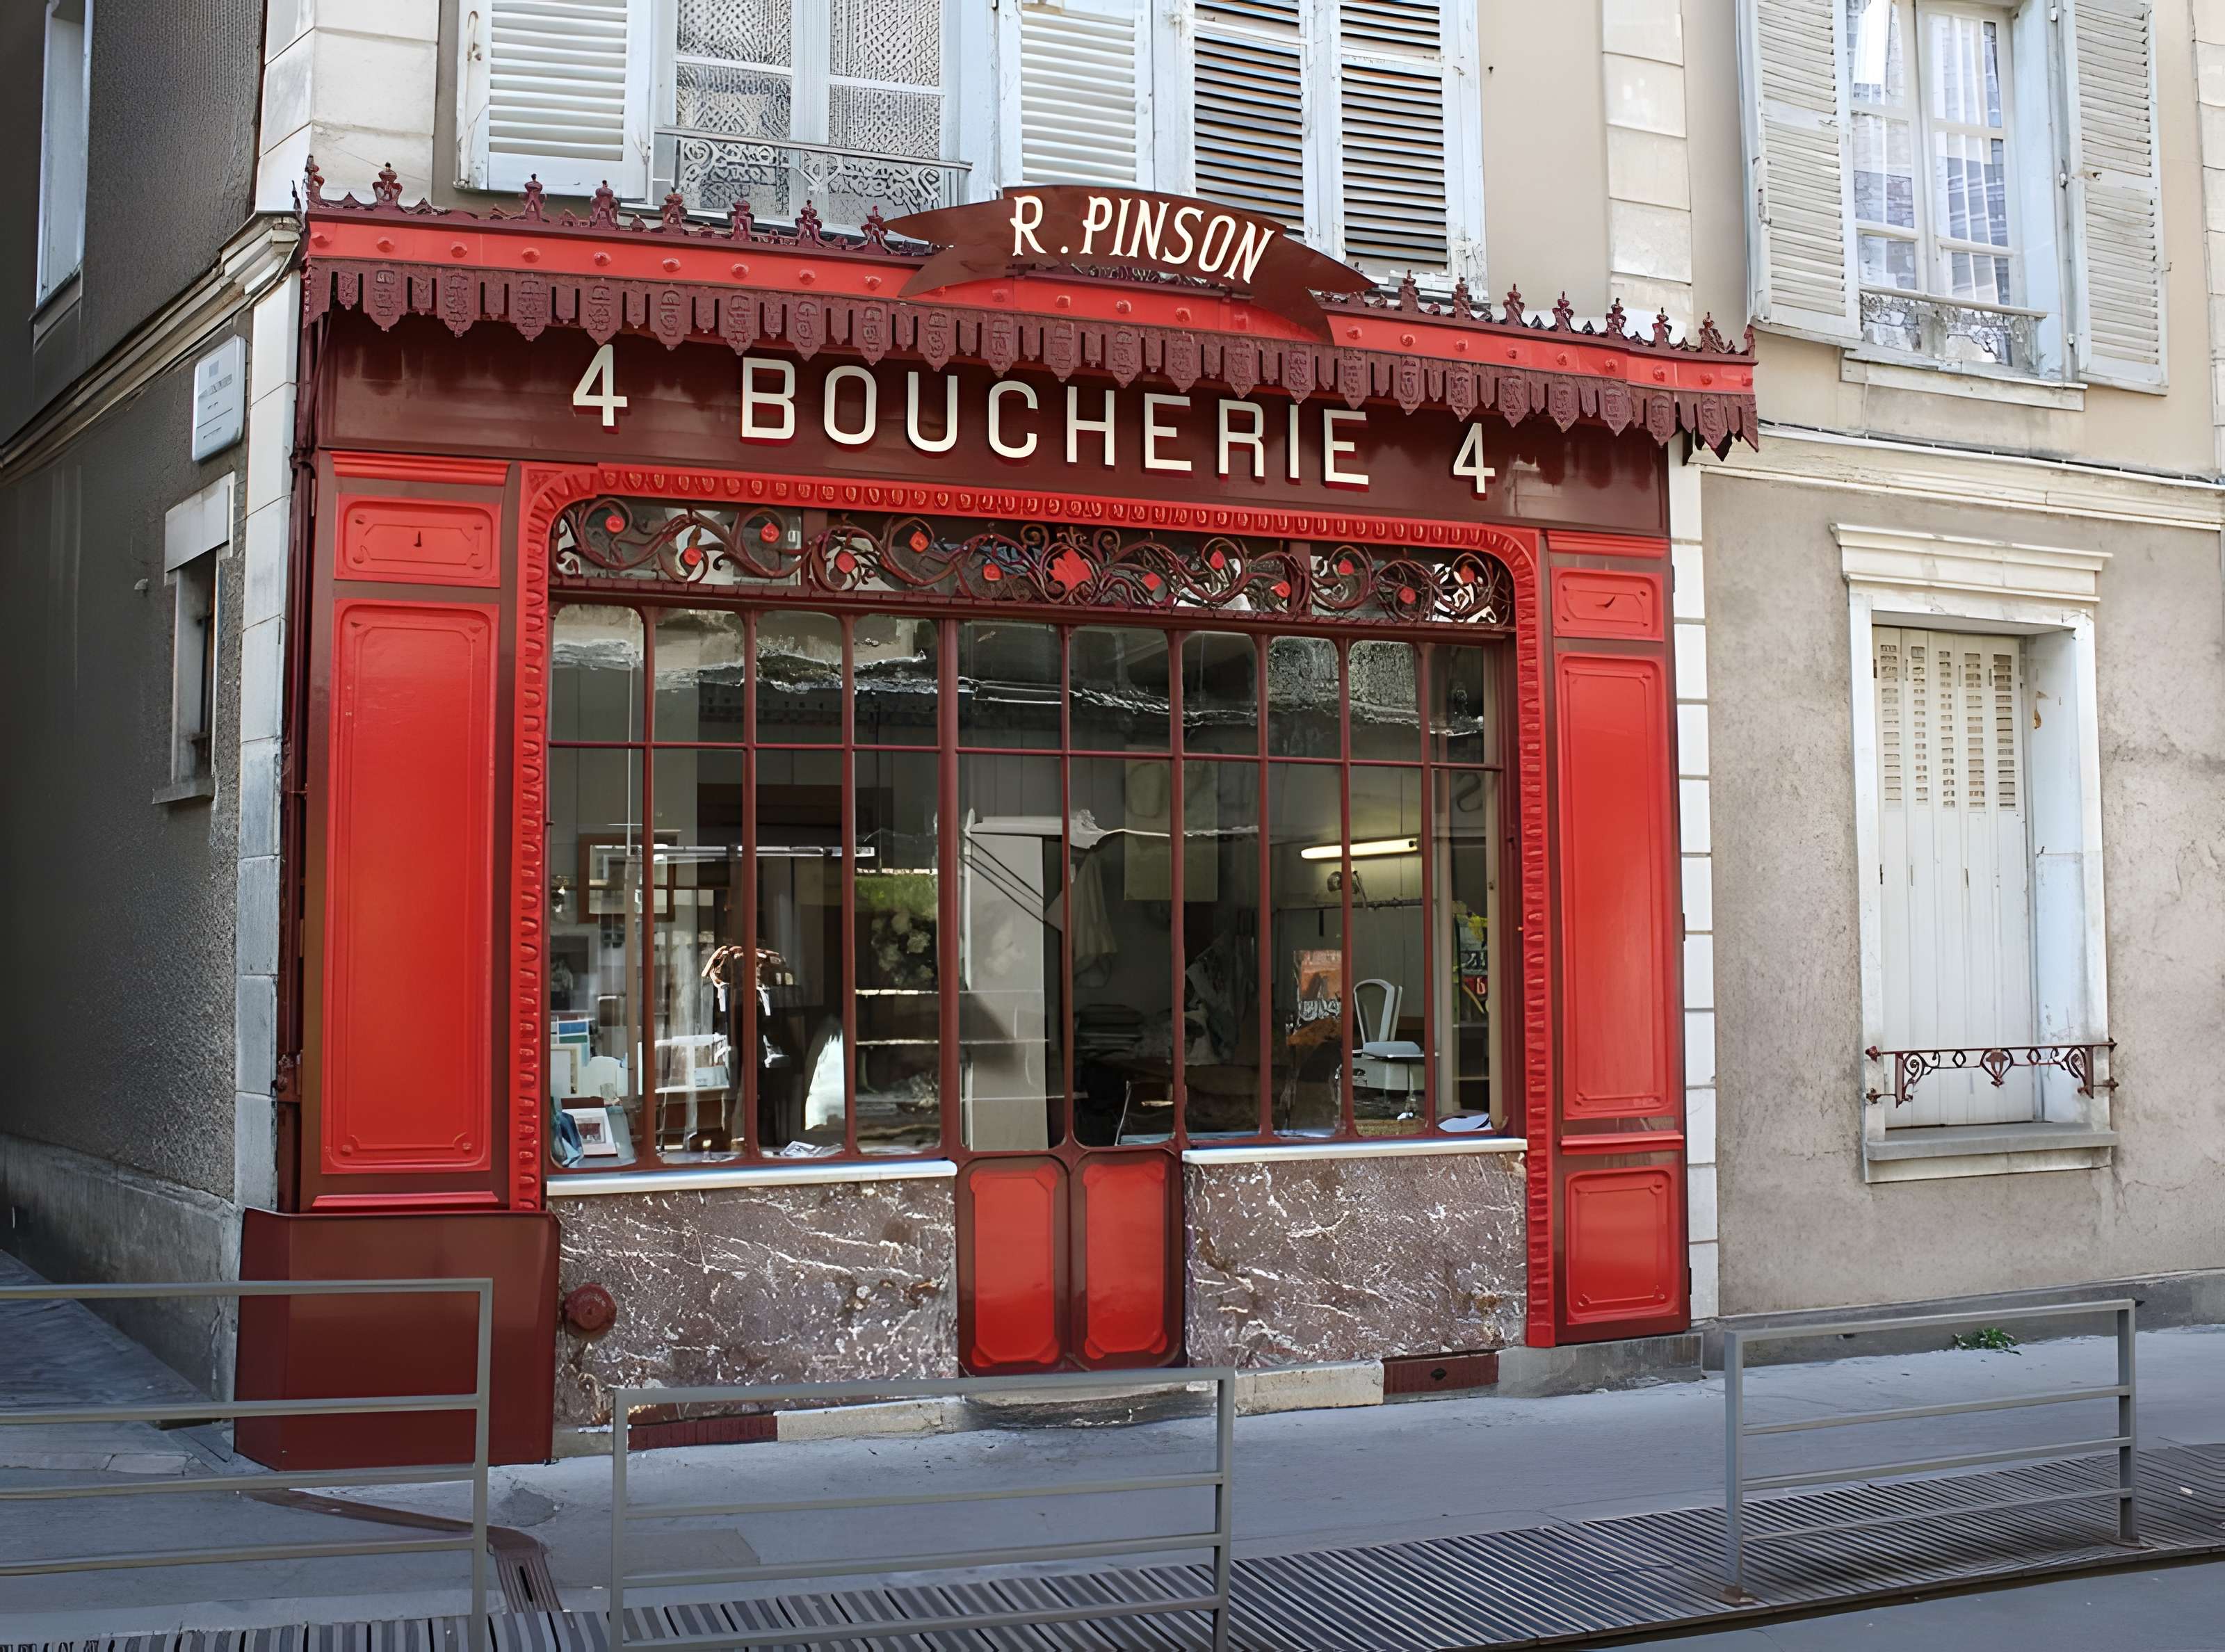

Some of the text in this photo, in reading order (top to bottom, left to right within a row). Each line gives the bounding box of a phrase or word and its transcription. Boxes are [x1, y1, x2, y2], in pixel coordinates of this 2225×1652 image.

[1080, 195, 1275, 284] PINSON
[572, 344, 1496, 494] 4 BOUCHERIE 4
